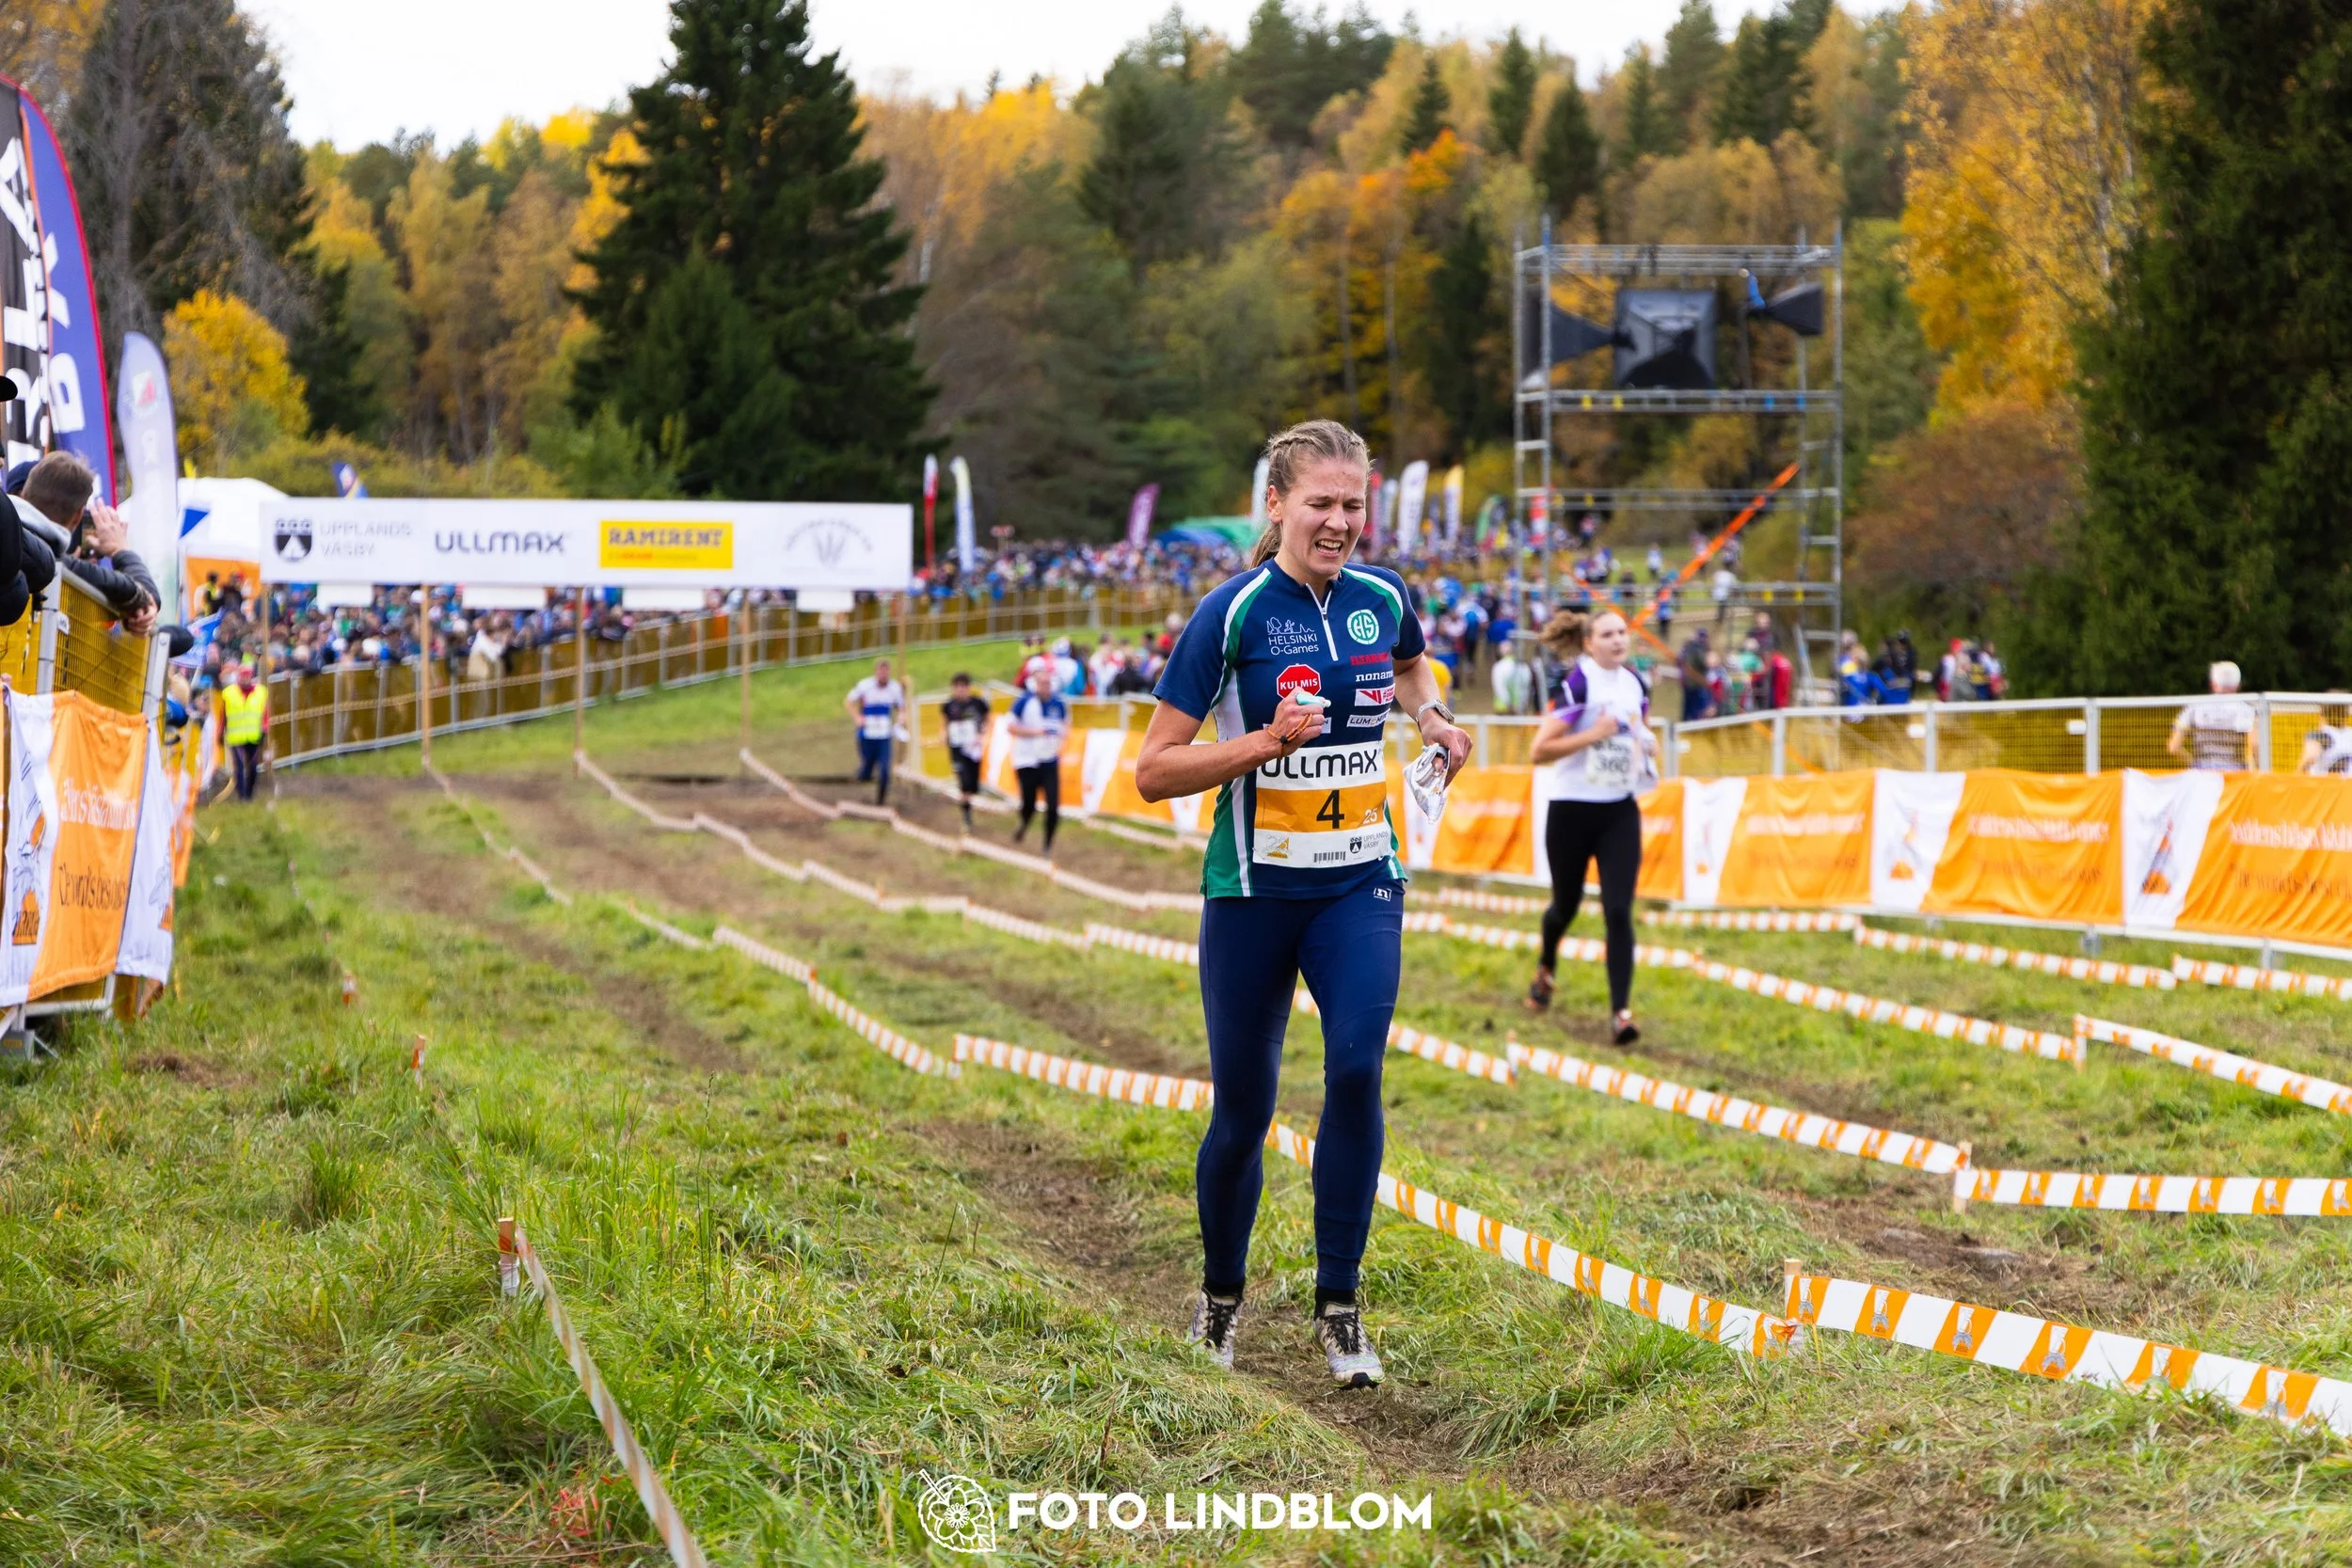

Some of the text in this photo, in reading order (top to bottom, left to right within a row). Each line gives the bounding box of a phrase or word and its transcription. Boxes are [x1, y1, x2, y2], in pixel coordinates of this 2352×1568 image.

[435, 530, 564, 554] ULLMAX
[609, 528, 723, 547] RAMIRENT
[1268, 633, 1318, 646] HELSINKI
[1270, 644, 1319, 656] O-Games
[1279, 678, 1318, 690] KULMIS
[1261, 749, 1377, 779] ULLMAX
[1316, 789, 1345, 830] 4
